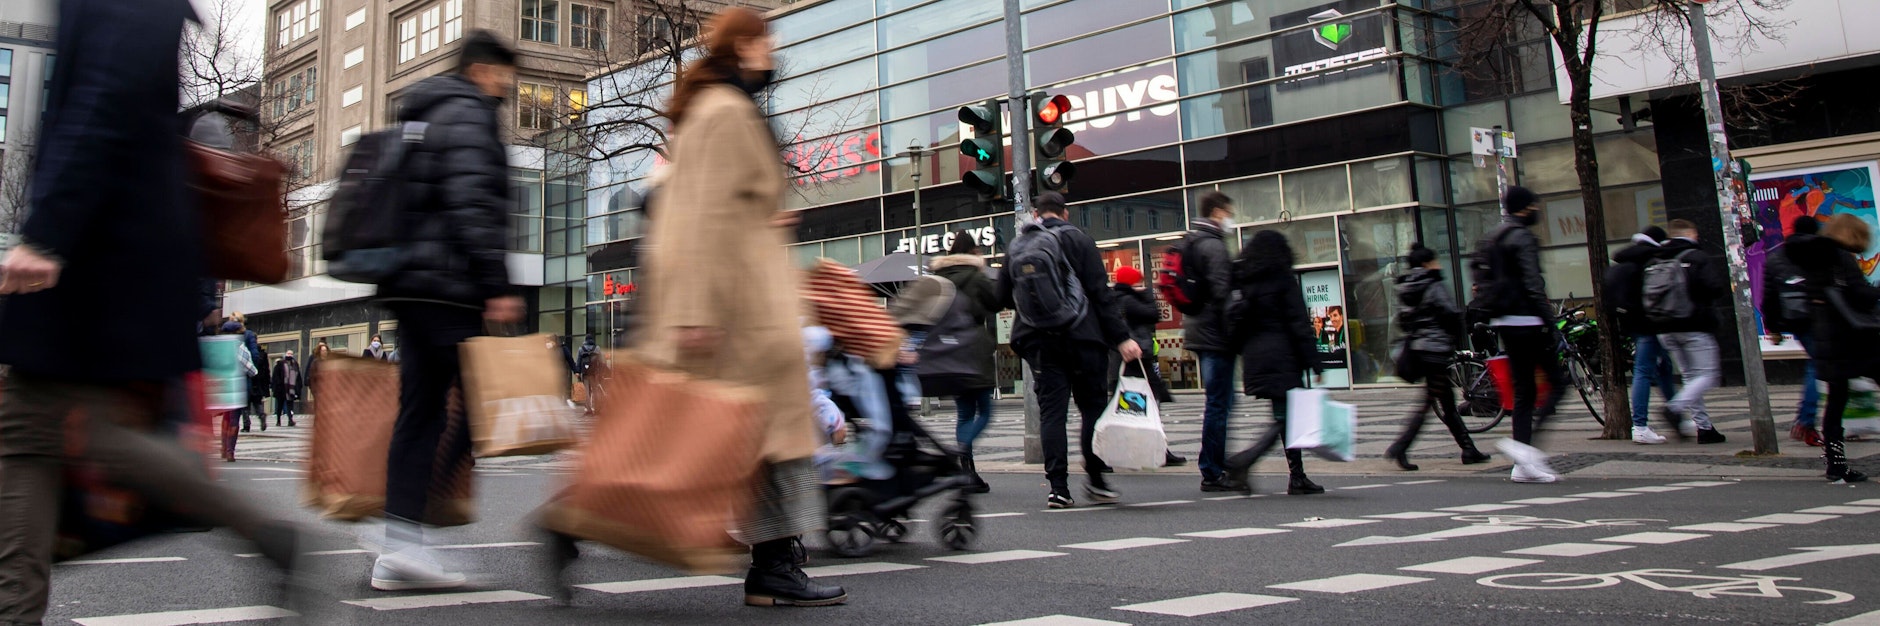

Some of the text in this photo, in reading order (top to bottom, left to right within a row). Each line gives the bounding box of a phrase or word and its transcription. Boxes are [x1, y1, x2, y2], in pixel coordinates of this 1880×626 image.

[1060, 74, 1178, 133] GUYS
[784, 131, 880, 185] kass
[899, 225, 997, 255] FIVE GYS
[1306, 284, 1329, 294] WE ARE
[1307, 293, 1330, 303] HIRING.
